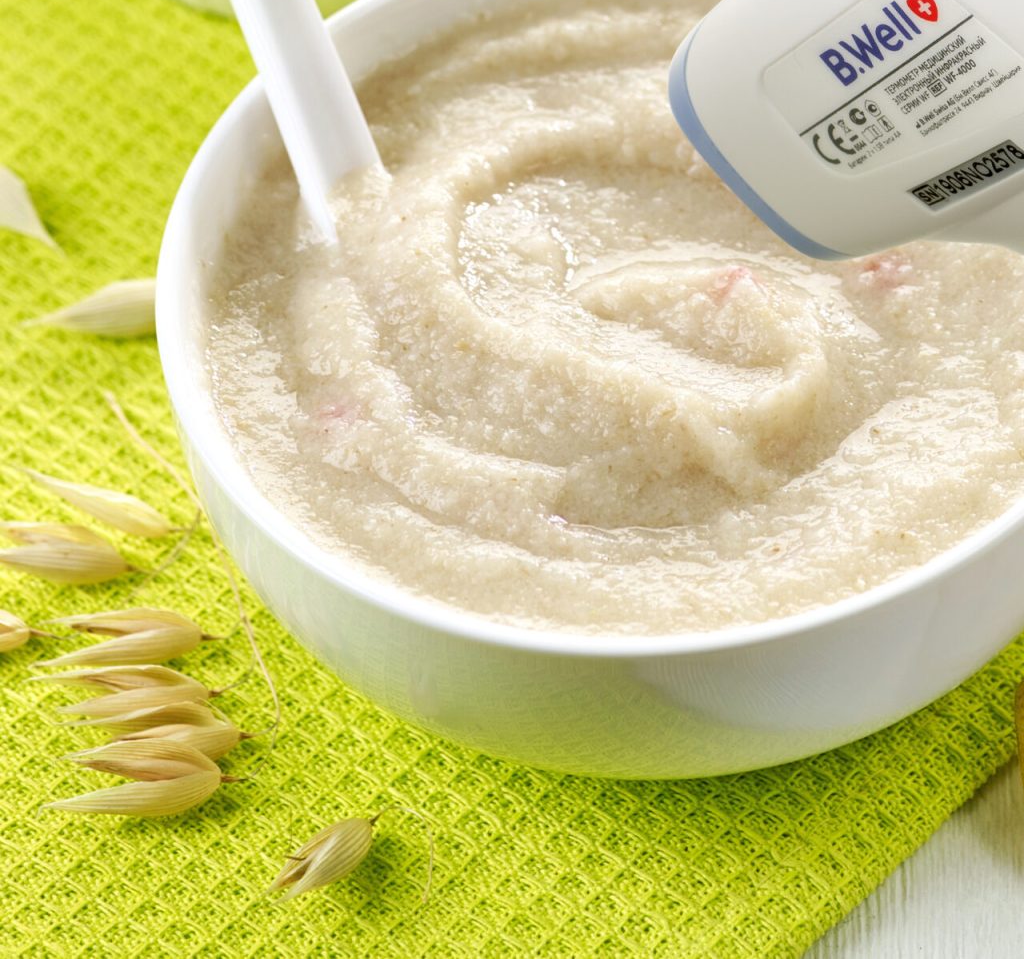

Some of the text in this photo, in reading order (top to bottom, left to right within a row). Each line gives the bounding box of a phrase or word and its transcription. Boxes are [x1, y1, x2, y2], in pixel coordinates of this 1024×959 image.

[819, 0, 922, 87] B.Well
[884, 34, 966, 96] ТЕРМОМЕТР МЕДИЦИНСКИЙ
[892, 35, 987, 106] ЭЛЕКТРОННЫЙ ИНФРАКРАСНЫЙ
[901, 59, 977, 115] СЕРИИ WF REF WF-4000
[918, 187, 939, 202] SN
